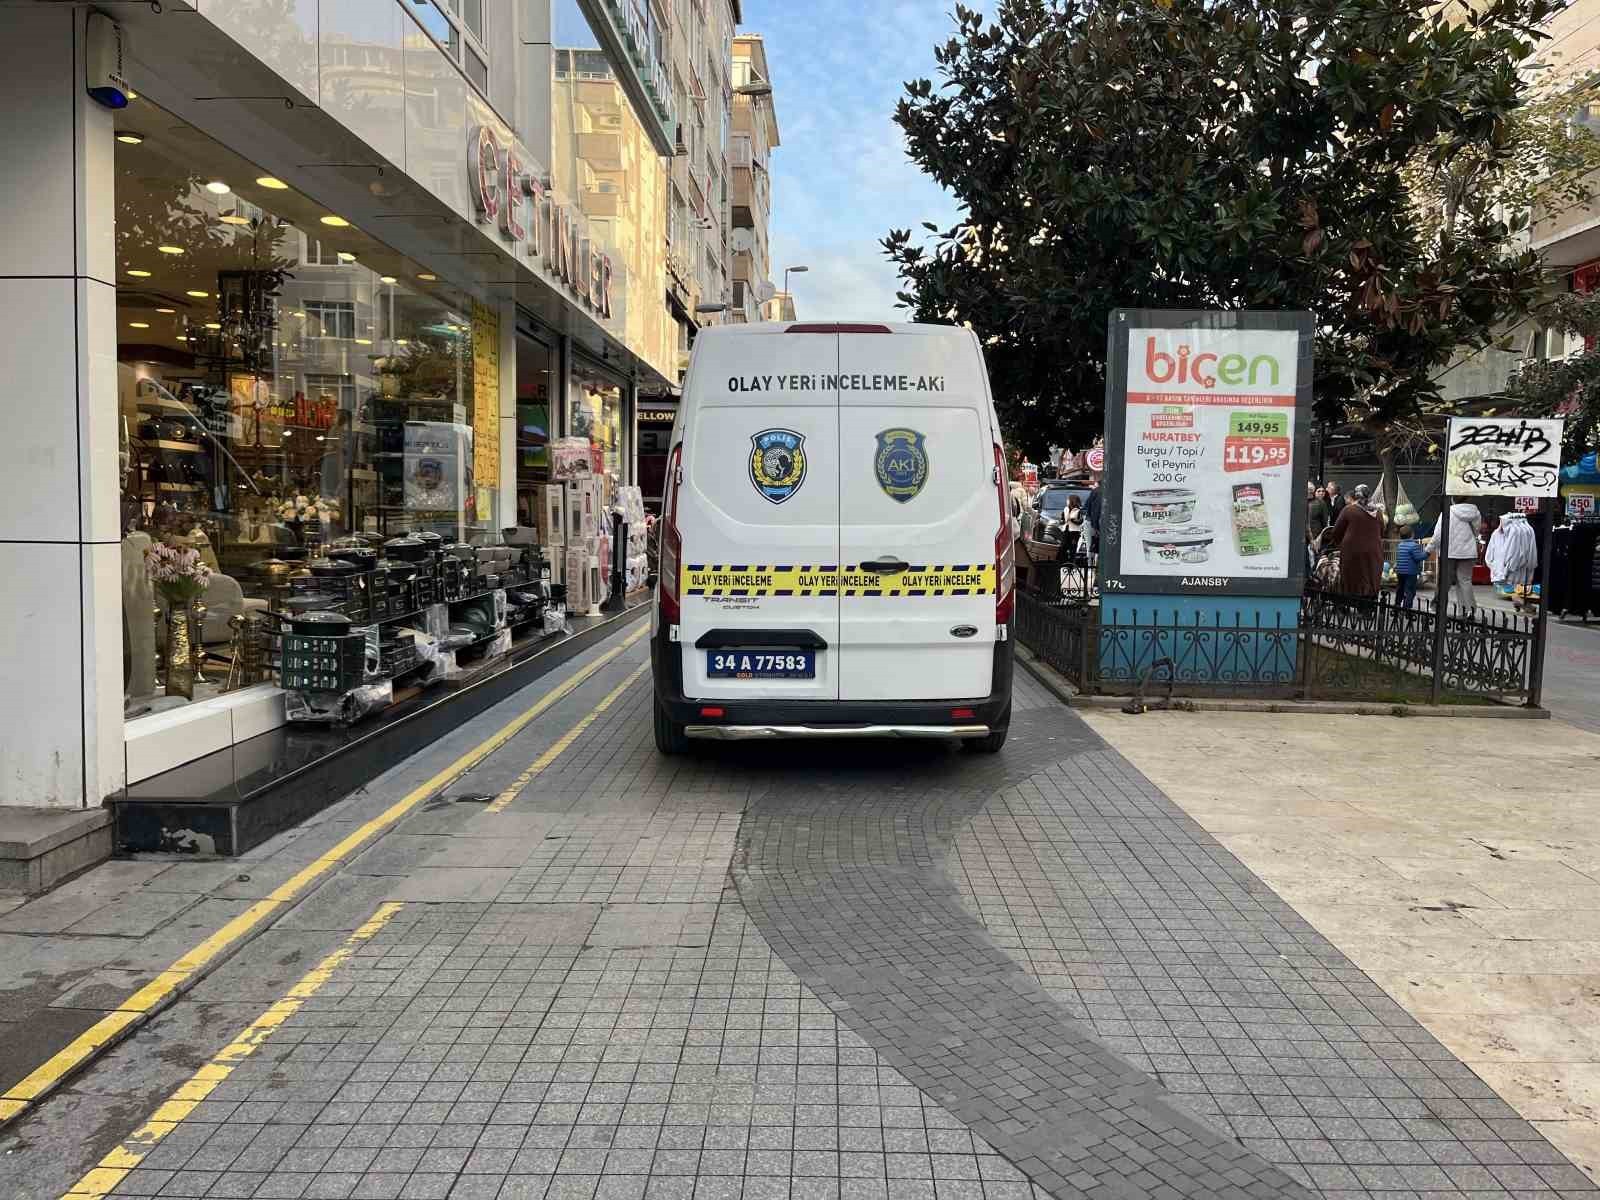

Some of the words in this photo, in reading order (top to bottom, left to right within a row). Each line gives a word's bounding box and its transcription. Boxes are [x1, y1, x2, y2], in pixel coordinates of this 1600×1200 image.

[728, 375, 773, 392] OLAY
[1237, 422, 1279, 435] 149,95
[1142, 432, 1201, 442] MURATBEY
[1137, 446, 1167, 457] Burgu
[1226, 446, 1287, 464] 119,95
[1145, 459, 1160, 469] Tel
[1163, 459, 1196, 471] Peyniri
[1153, 473, 1172, 482] 200
[1175, 473, 1187, 483] Gr
[1516, 496, 1534, 506] 450
[1570, 499, 1590, 508] 450
[1142, 511, 1172, 520] Burgu
[692, 574, 711, 586] OLAY
[798, 575, 819, 586] OLAY
[902, 575, 922, 586] OLAY
[1181, 576, 1229, 587] AJANSBY
[714, 655, 736, 670] 34
[740, 655, 752, 670] A
[755, 655, 806, 670] 77583
